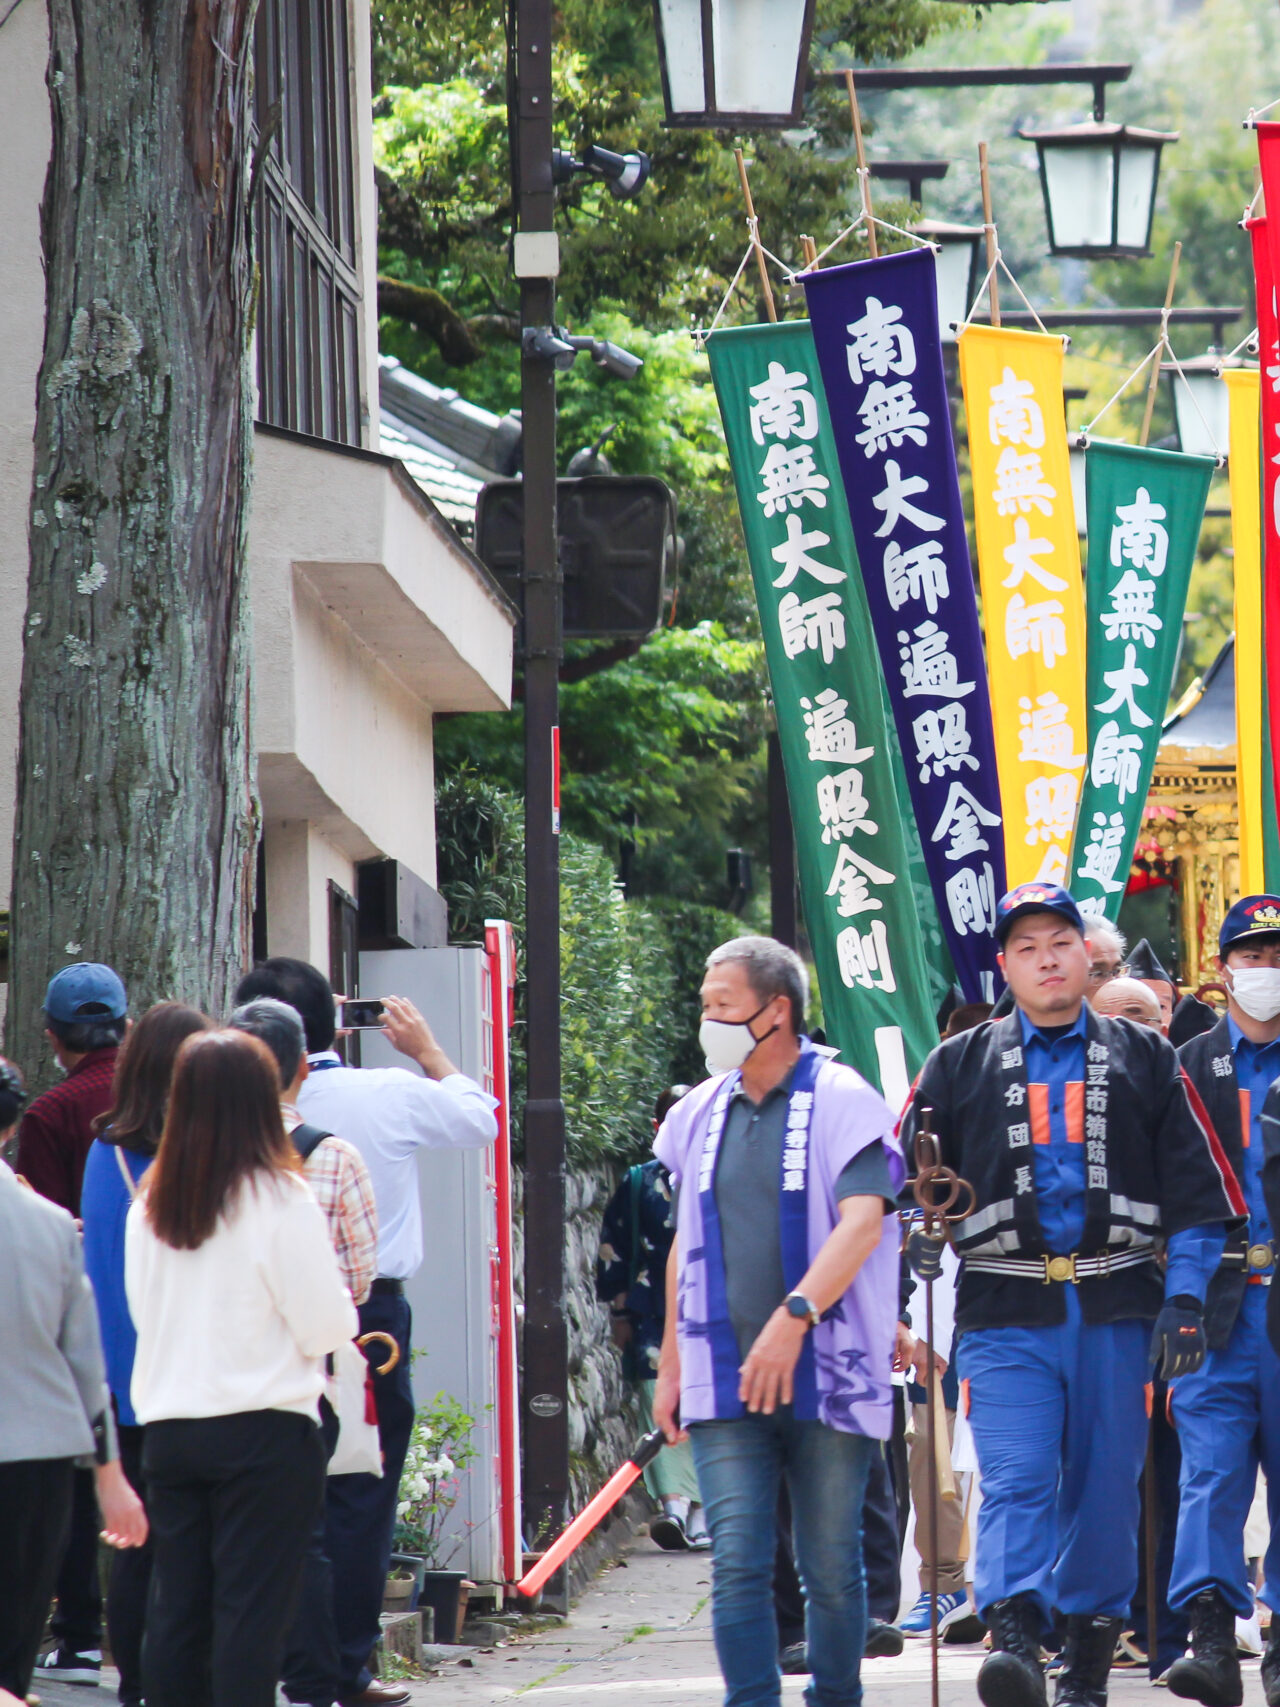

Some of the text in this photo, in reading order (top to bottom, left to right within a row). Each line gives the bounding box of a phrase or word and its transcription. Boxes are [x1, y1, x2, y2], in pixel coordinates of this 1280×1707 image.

[1001, 1046, 1032, 1195] 副分団長
[1086, 1041, 1110, 1190] 伊豆市消防団
